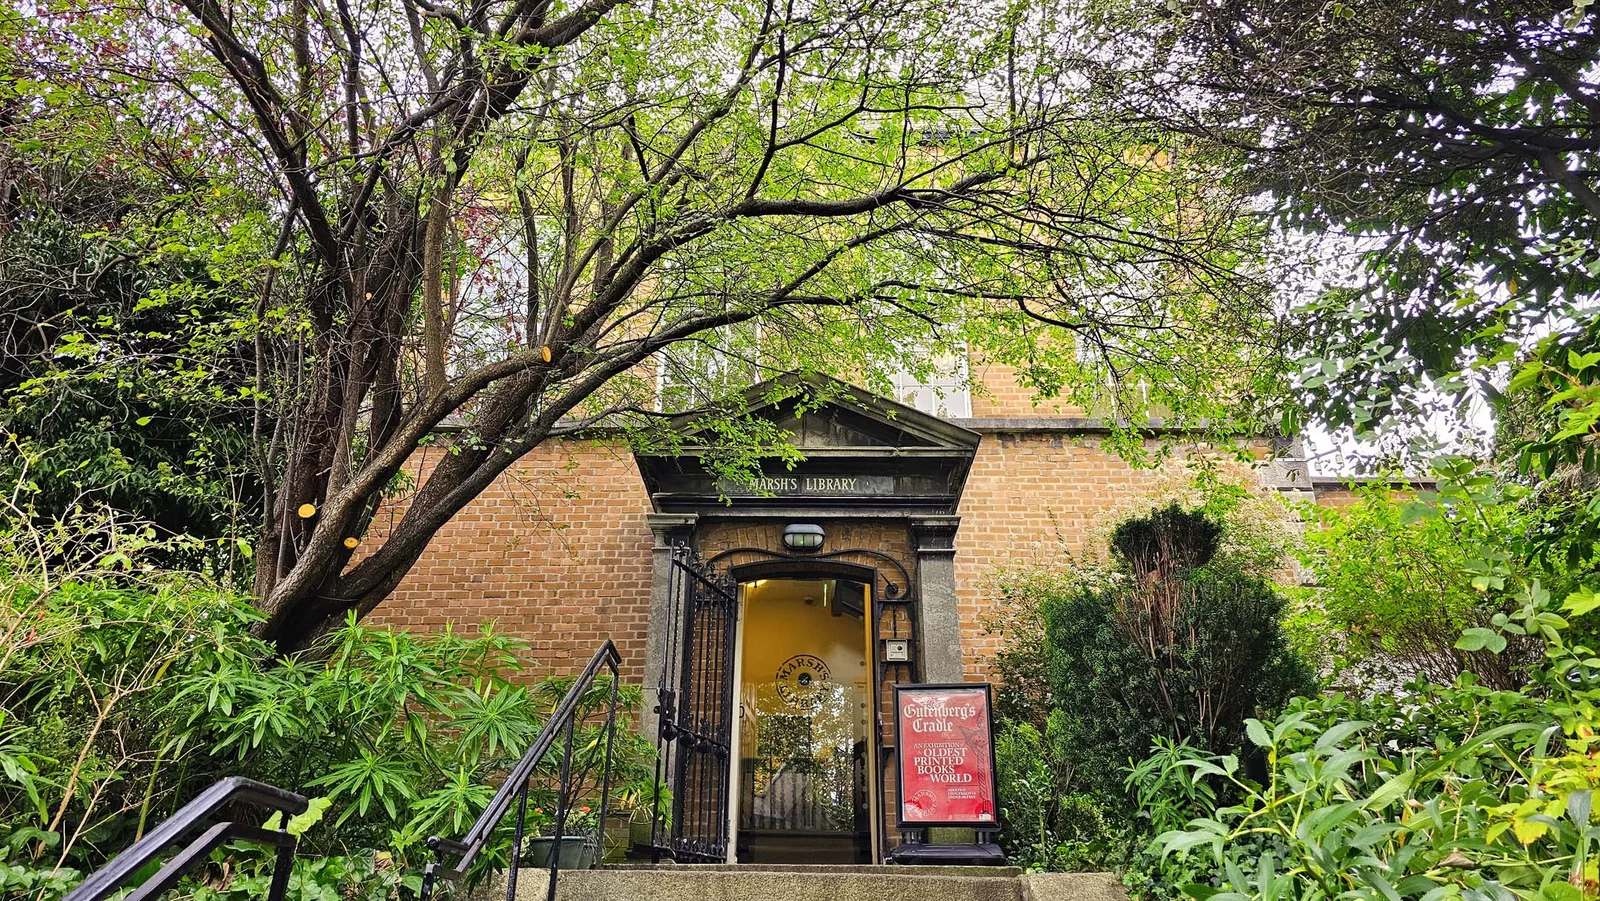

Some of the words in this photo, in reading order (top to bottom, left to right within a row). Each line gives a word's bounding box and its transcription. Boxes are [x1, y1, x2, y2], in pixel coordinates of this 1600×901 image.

[749, 478, 798, 490] MARSH'S
[806, 478, 857, 491] LIBRARY
[780, 658, 830, 681] MARSH'S
[903, 702, 976, 720] Gutenberg's
[912, 718, 954, 733] Cradle
[923, 747, 968, 757] OLDEST
[914, 756, 964, 766] PRINTED
[917, 765, 955, 775] BOOKS
[930, 773, 972, 783] WORLD
